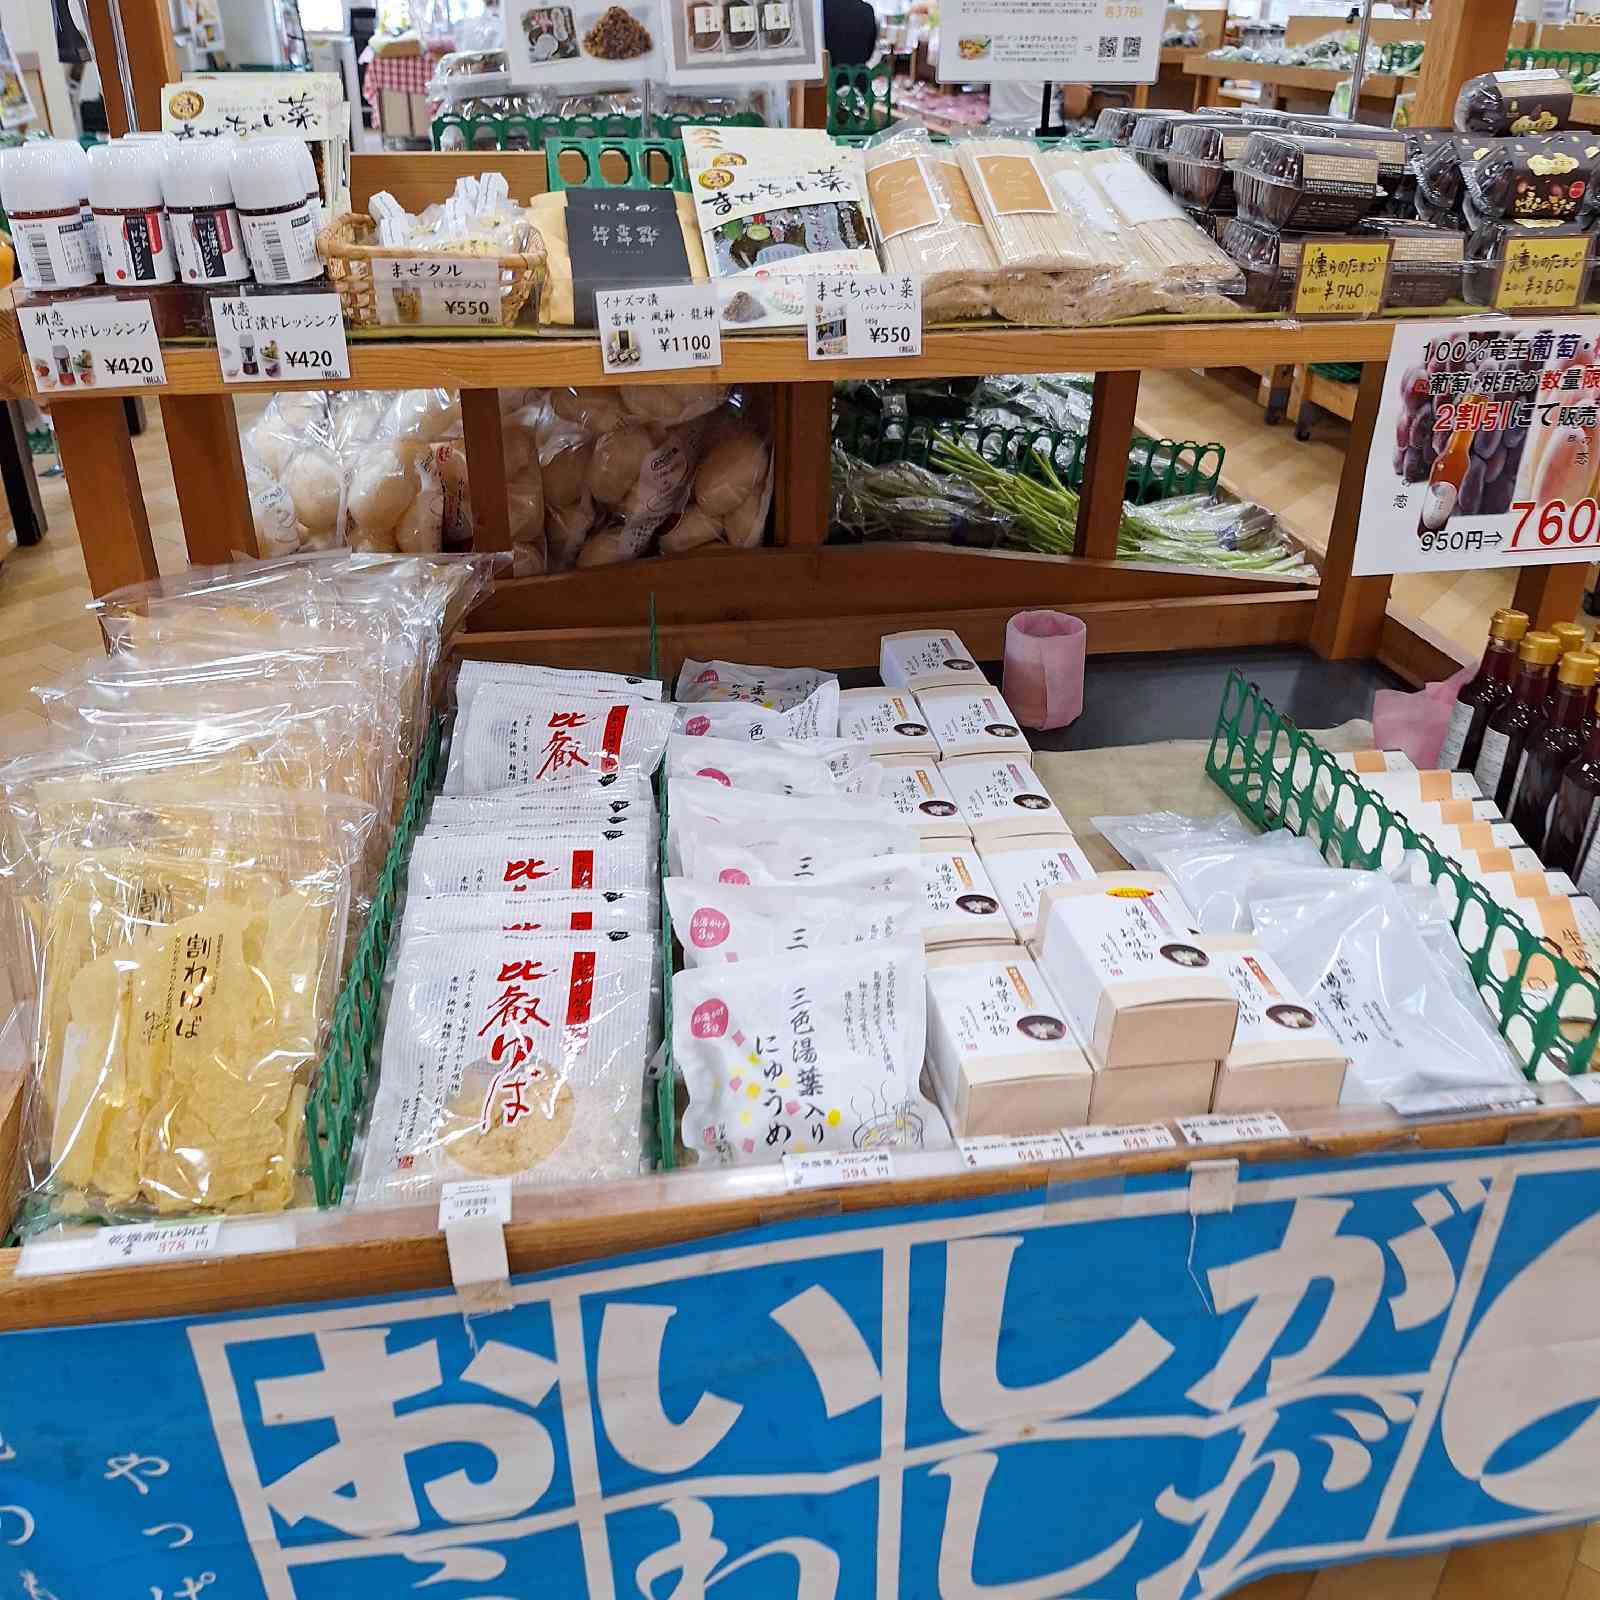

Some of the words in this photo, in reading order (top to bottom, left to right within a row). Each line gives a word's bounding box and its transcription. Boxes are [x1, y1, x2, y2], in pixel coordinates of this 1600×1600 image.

[1324, 280, 1364, 302] ¥740
[443, 301, 489, 315] ¥550
[46, 320, 150, 341] トマトドレッシング
[231, 313, 340, 332] しば漬ドレッシング
[660, 334, 711, 352] ¥1100
[869, 326, 911, 343] ¥550
[285, 350, 333, 368] ¥420
[1423, 334, 1600, 363] 100%竜王葡萄・
[104, 356, 154, 375] ¥420
[1432, 401, 1597, 432] 2割引にて販売
[1511, 498, 1600, 548] 760
[1420, 530, 1484, 553] 950円
[503, 858, 560, 892] 比
[174, 931, 213, 1039] 割れゆば
[478, 959, 559, 1136] 比叡ゆば
[787, 986, 825, 1144] 三色湯葉入り
[756, 1034, 793, 1157] にゅうめ
